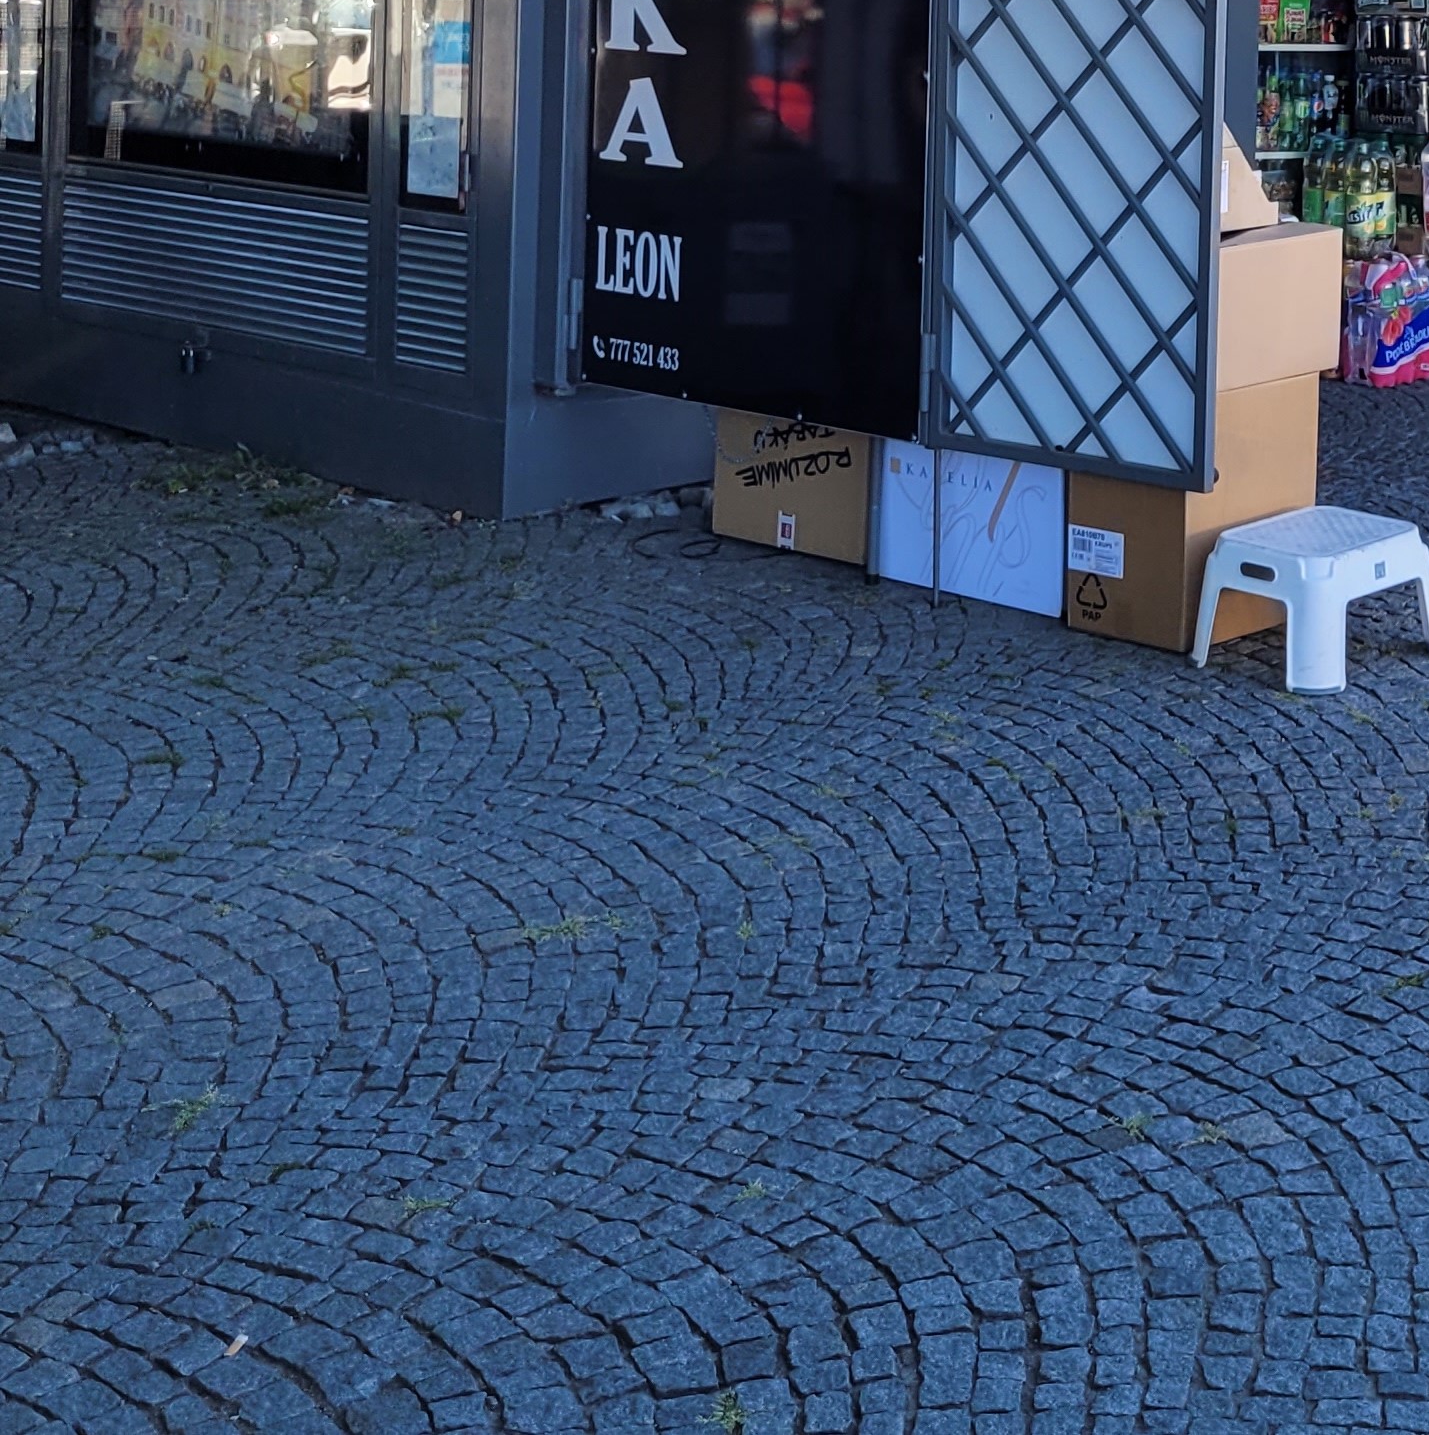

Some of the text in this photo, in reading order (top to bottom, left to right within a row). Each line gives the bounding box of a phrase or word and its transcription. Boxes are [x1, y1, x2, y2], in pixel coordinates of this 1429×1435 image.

[1369, 54, 1412, 66] MONSTER
[1371, 113, 1414, 125] MONSTER
[595, 224, 683, 303] LEON
[609, 337, 680, 371] 777 521 433
[906, 462, 992, 492] KAELIA
[1082, 608, 1101, 621] PAP
